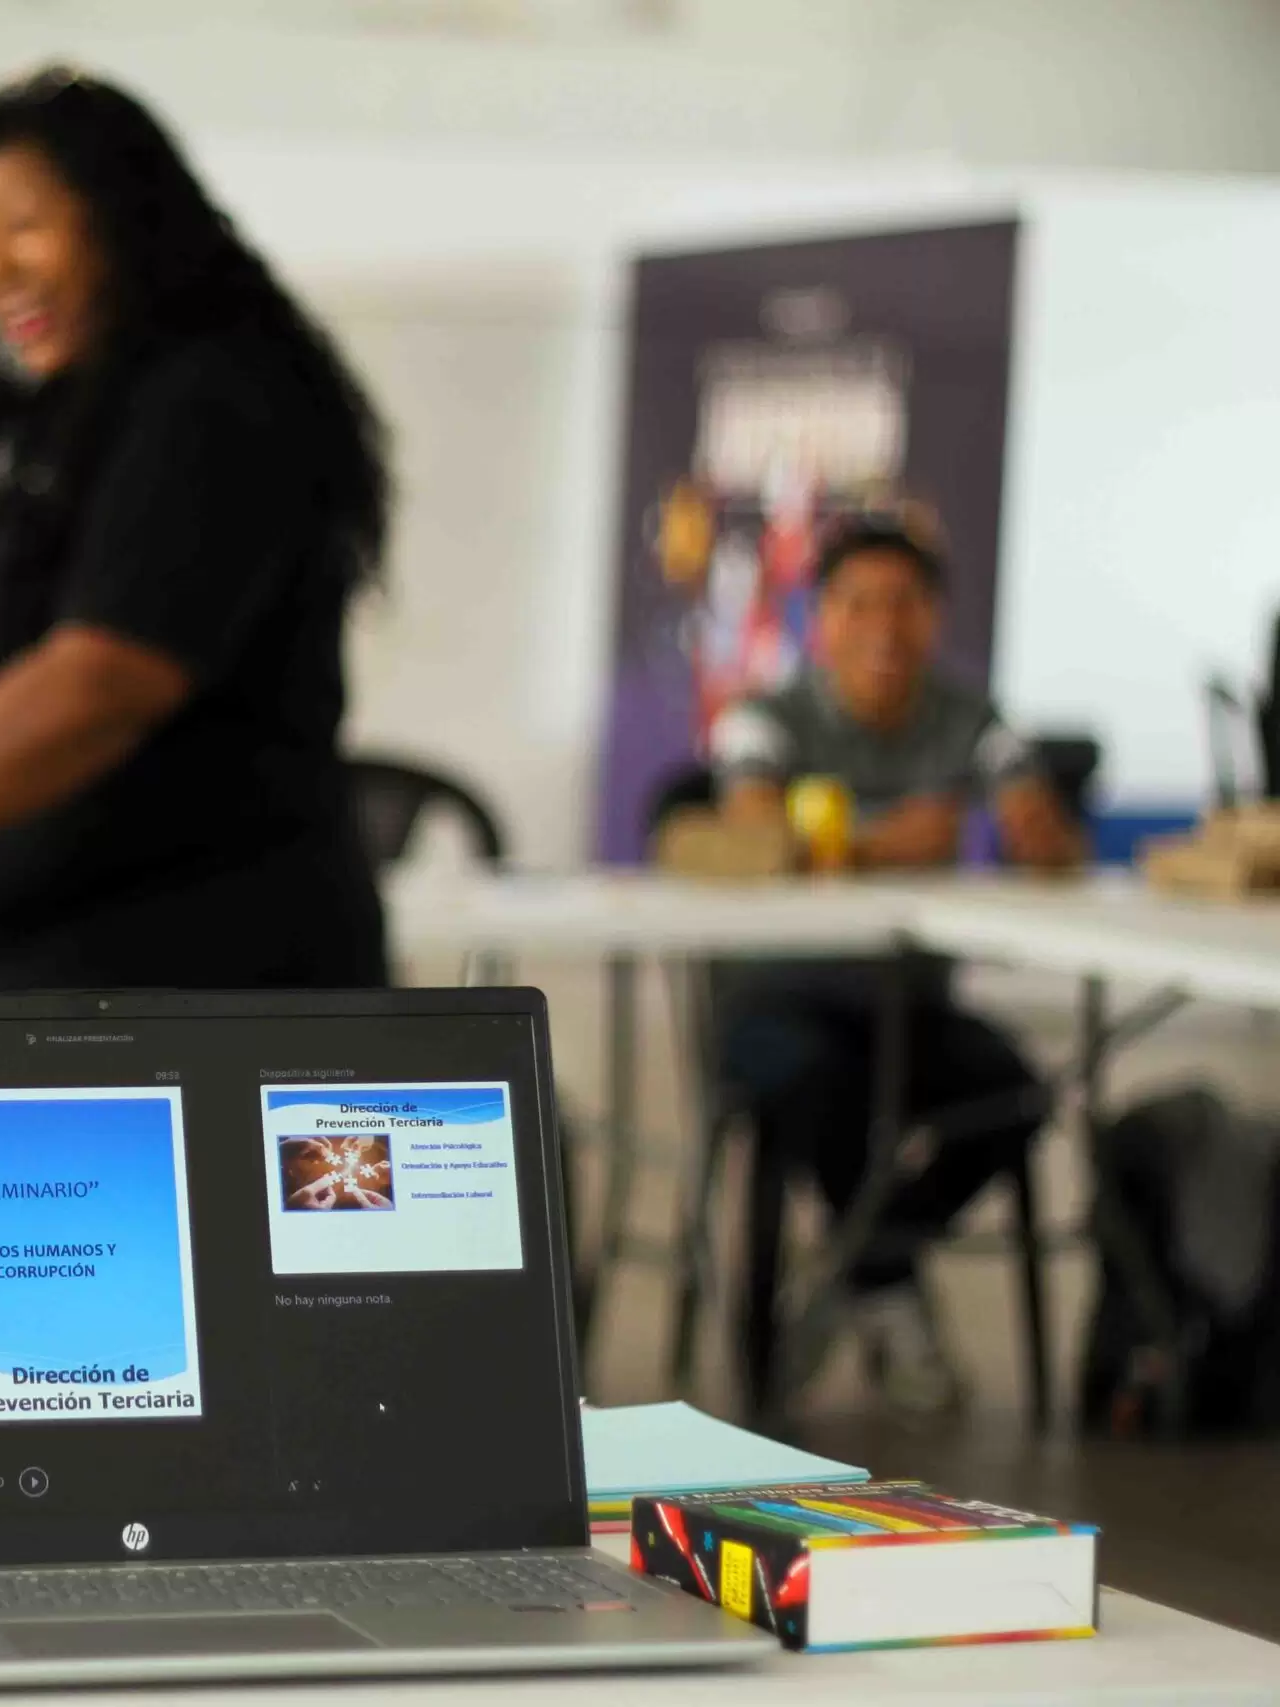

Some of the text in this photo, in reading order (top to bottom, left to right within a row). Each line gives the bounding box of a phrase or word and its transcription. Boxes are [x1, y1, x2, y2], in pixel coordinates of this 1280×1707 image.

[313, 1068, 355, 1079] siguiente
[340, 1101, 417, 1113] Dirección de
[315, 1116, 443, 1129] Prevención Terciaria
[23, 1243, 104, 1258] HUMANOS
[106, 1243, 116, 1256] Y
[275, 1295, 292, 1306] No
[295, 1295, 314, 1307] hay
[318, 1294, 362, 1307] ninguna
[12, 1364, 150, 1384] Dirección de
[98, 1389, 195, 1410] Terciaria
[126, 1523, 146, 1550] hp
